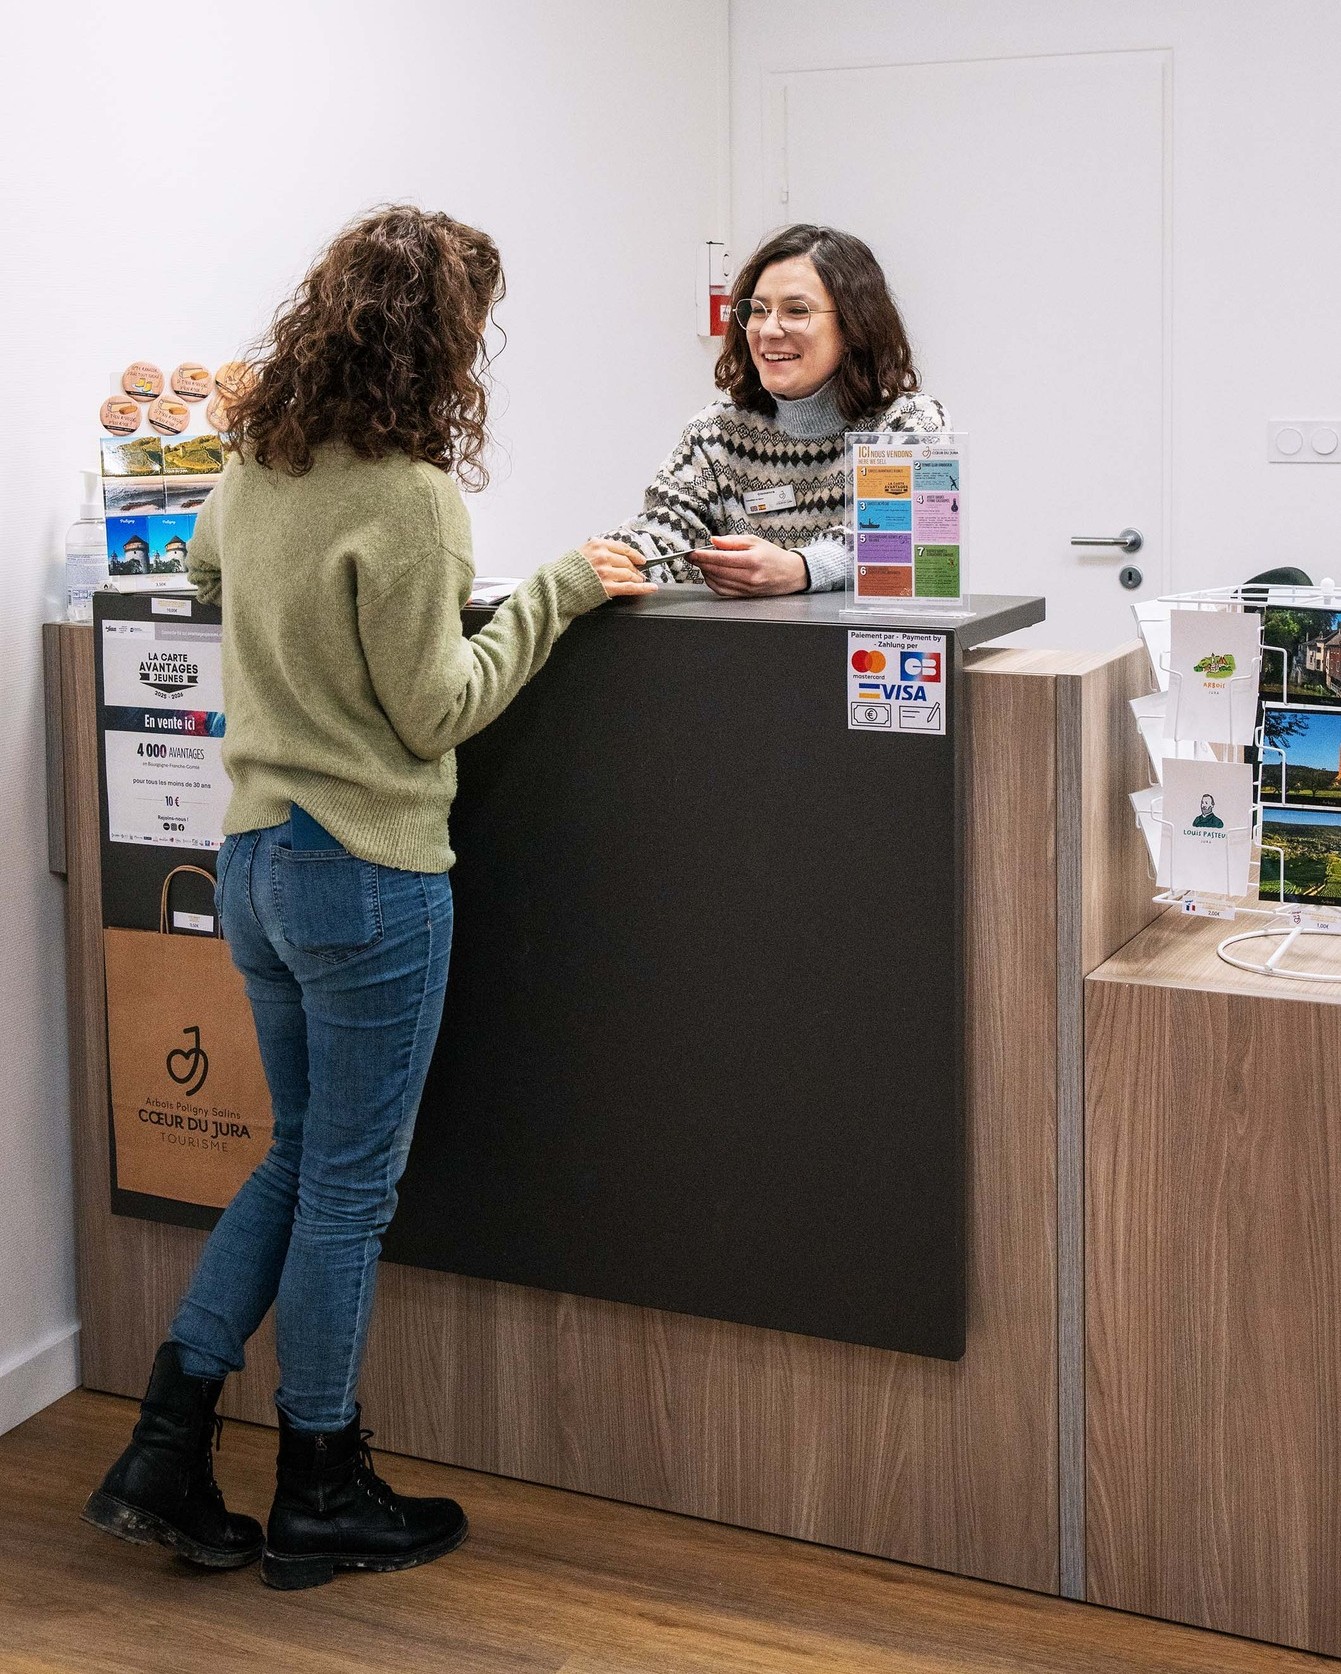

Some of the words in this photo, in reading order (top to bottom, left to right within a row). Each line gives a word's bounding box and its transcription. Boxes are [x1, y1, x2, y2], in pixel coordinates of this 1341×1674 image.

[858, 446, 870, 458] ICI
[870, 450, 886, 458] NOUS
[886, 450, 913, 458] VENDONS
[914, 461, 921, 470] 2
[916, 495, 924, 504] 4
[860, 501, 867, 511] 3
[860, 534, 867, 543] 5
[917, 546, 925, 556] 7
[860, 566, 867, 575] 6
[851, 632, 882, 640] Paiement
[883, 634, 895, 642] par
[902, 634, 931, 642] Payment
[933, 634, 942, 642] by
[878, 641, 905, 649] Zahlung
[148, 652, 159, 661] LA
[161, 653, 188, 662] CARTE
[139, 662, 198, 674] AVANTAGES
[153, 674, 184, 683] JEUNES
[154, 690, 167, 699] 2025
[880, 684, 927, 702] VISA
[144, 714, 155, 728] En
[158, 717, 183, 730] vente
[184, 717, 195, 730] ici
[137, 743, 145, 757] 4
[146, 743, 167, 758] 000
[168, 747, 205, 760] AVANTAGES
[165, 795, 174, 807] 10
[174, 796, 180, 807] €
[1203, 831, 1227, 839] PASTEU
[145, 1097, 174, 1109] Arbois
[176, 1101, 209, 1117] Poligny
[212, 1108, 241, 1119] Salins
[138, 1108, 184, 1129] CŒUR
[187, 1117, 208, 1133] DU
[210, 1121, 251, 1139] JURA
[160, 1132, 229, 1152] TOURISME
